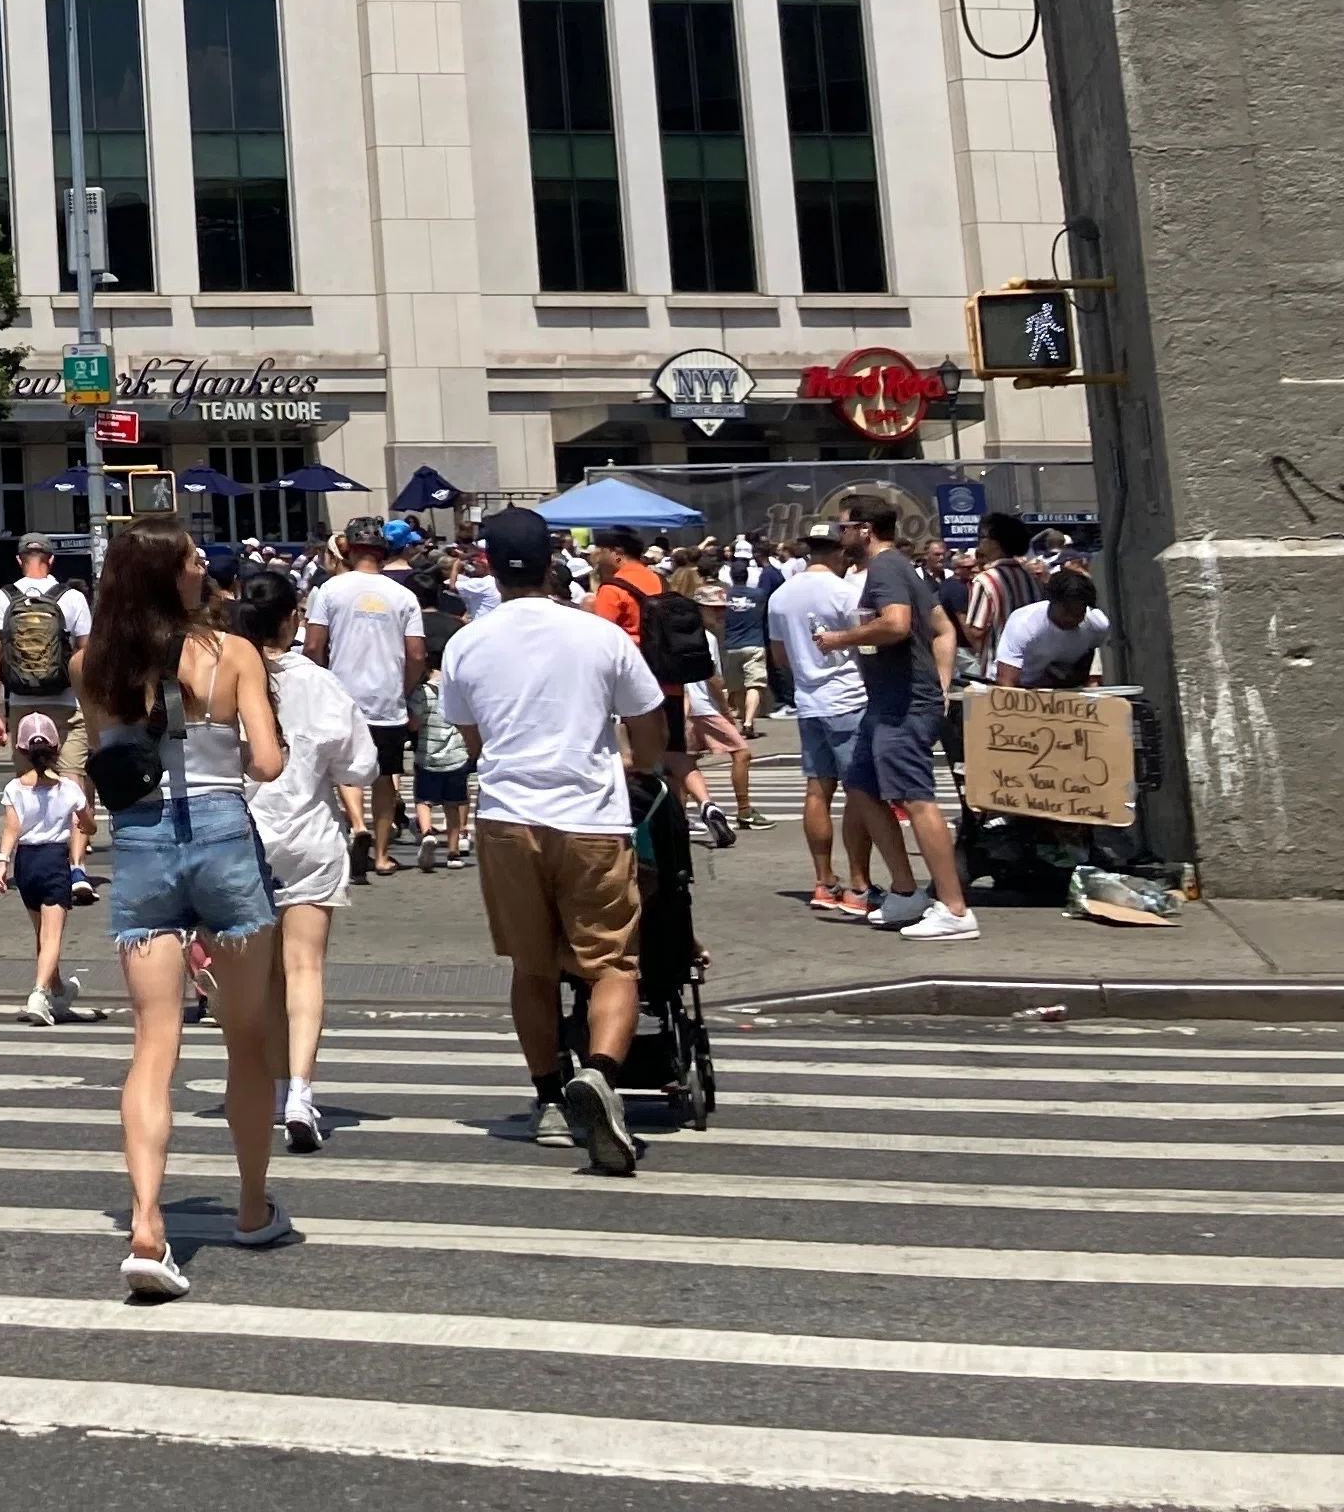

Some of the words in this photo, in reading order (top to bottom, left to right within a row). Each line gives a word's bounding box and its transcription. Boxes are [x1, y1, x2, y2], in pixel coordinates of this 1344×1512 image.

[14, 372, 61, 396] ew
[162, 357, 319, 417] Yankees
[672, 368, 739, 403] NYY
[804, 365, 878, 398] Hard
[883, 365, 946, 402] Roc
[198, 401, 257, 421] TEAM
[261, 401, 322, 421] STORE
[675, 406, 741, 416] STEAK
[944, 515, 981, 524] STADIUM
[951, 525, 979, 534] ENTRY
[990, 689, 1036, 712] COLD
[1036, 692, 1099, 721] WATER
[1028, 727, 1059, 771] 2
[992, 769, 1024, 788] Yes
[1029, 772, 1056, 791] You
[1062, 778, 1091, 794] Can
[989, 789, 1021, 808] Take
[1025, 792, 1064, 813] Water
